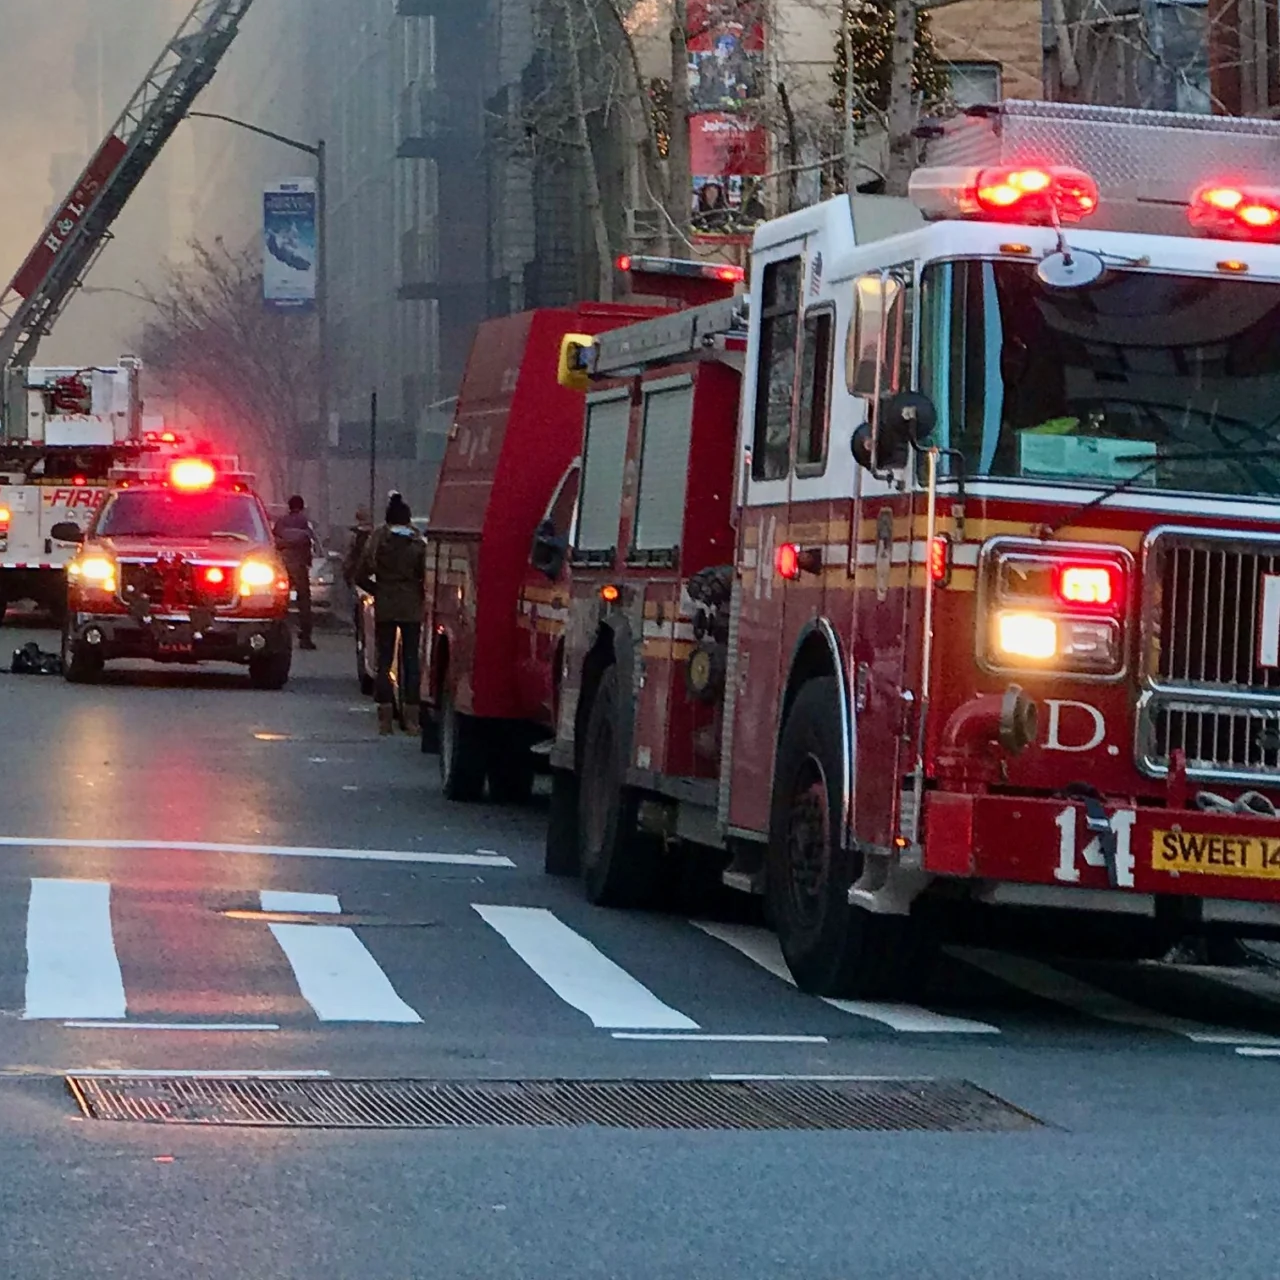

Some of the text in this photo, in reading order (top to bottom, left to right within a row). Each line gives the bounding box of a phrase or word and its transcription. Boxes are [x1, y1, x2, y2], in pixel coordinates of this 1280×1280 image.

[1042, 698, 1120, 756] D.
[1053, 806, 1137, 888] 14
[1162, 832, 1252, 868] SWEET
